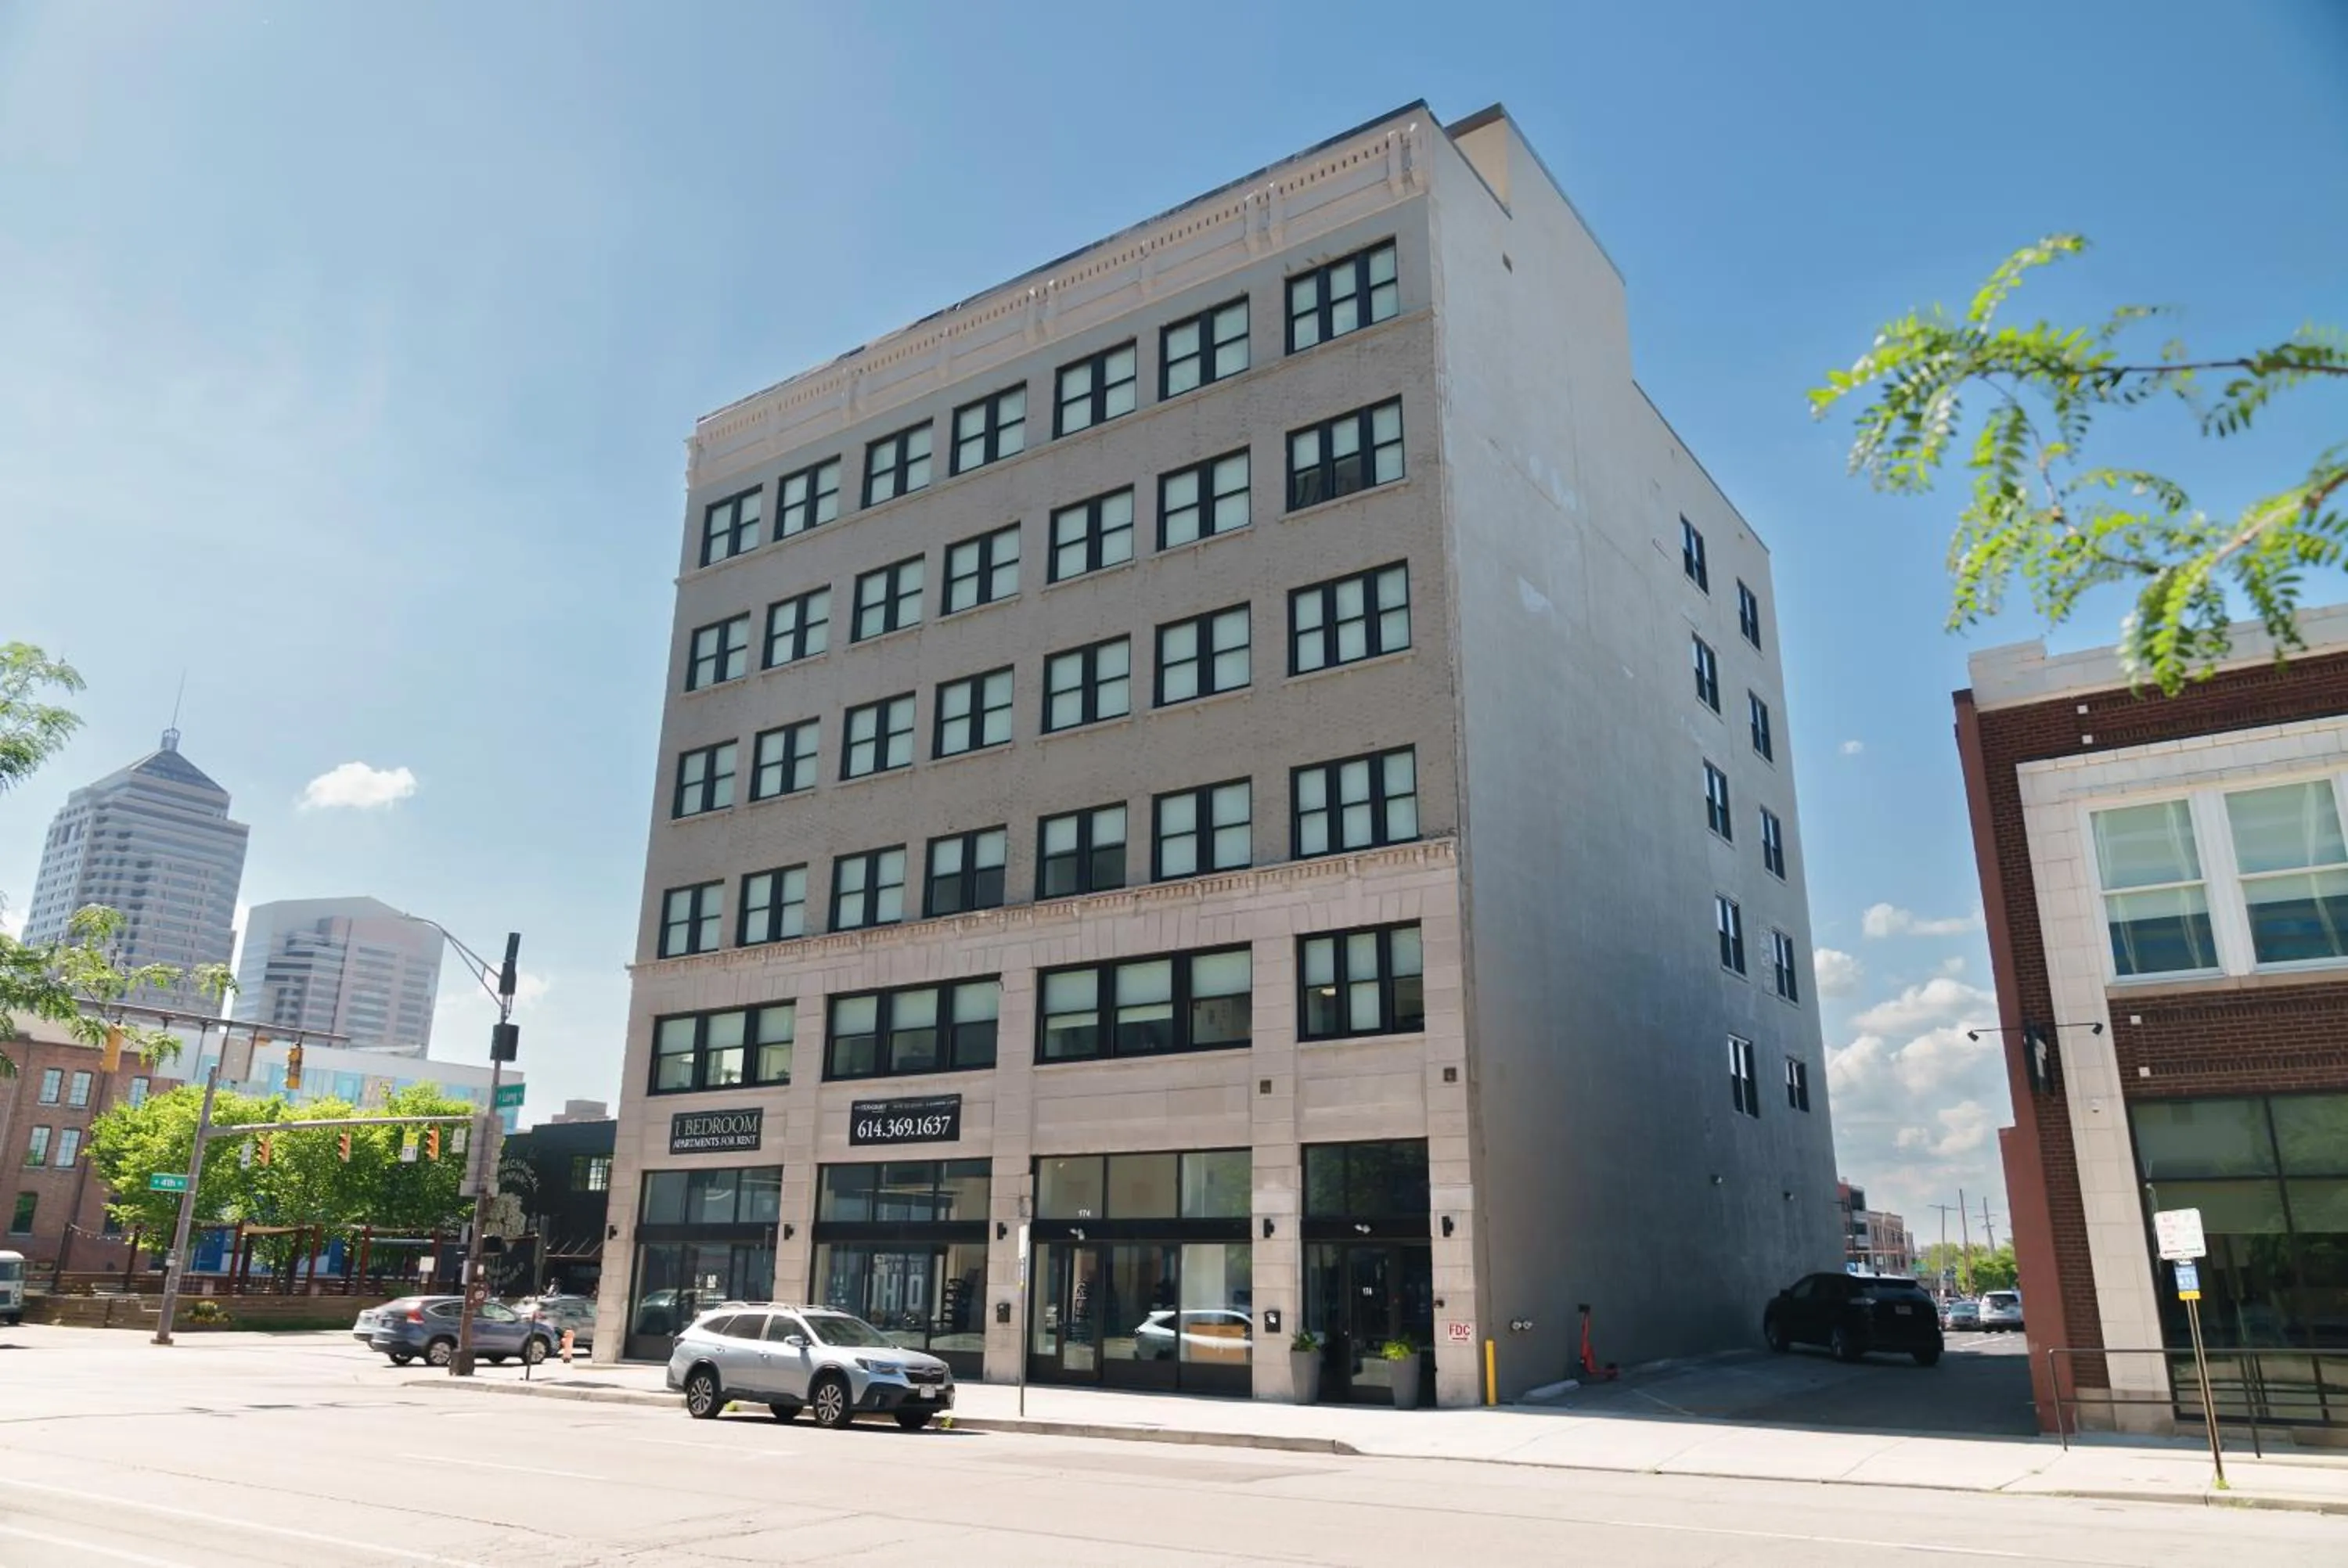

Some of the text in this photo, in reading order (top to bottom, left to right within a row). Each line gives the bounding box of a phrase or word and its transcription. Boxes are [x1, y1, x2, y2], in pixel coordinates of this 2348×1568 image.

[684, 1115, 758, 1136] BEDROOM
[857, 1115, 952, 1138] 614.369.1637
[673, 1137, 719, 1149] APARTMENTS
[736, 1135, 757, 1145] RENT
[160, 1178, 176, 1187] 4th
[1449, 1323, 1470, 1336] FDC
